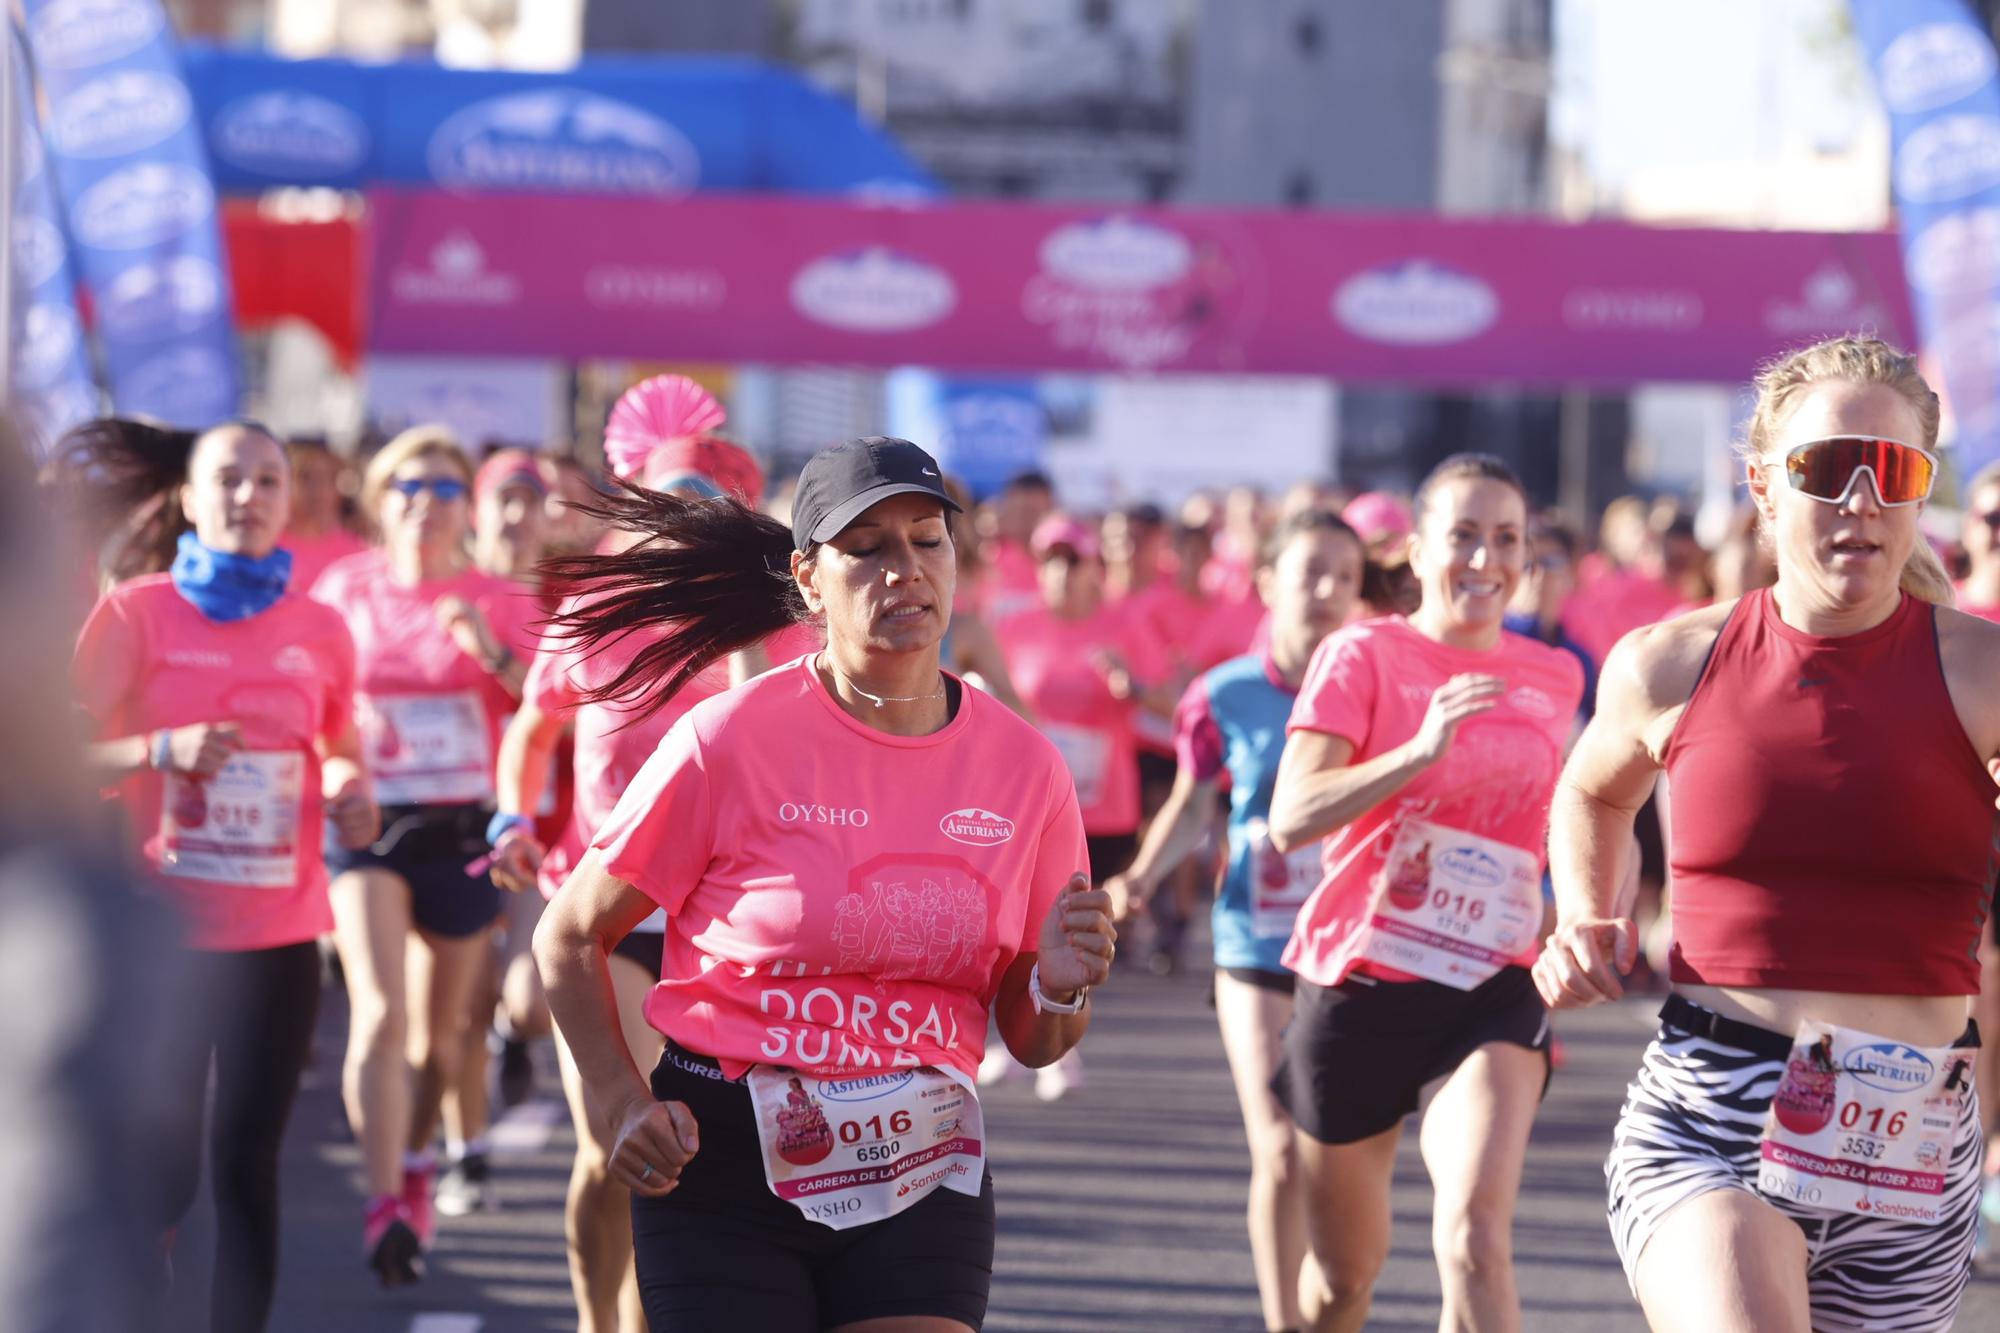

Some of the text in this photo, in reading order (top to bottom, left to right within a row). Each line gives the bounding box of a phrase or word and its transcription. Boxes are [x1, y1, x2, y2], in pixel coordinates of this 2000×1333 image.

[779, 802, 869, 827] OYSHO
[946, 818, 1010, 837] ASTURIANA
[1432, 888, 1485, 921] 016
[760, 987, 960, 1049] DORSAL
[827, 1072, 910, 1096] ASTURIANA
[839, 1110, 912, 1143] 016
[1839, 1101, 1908, 1137] 016
[857, 1140, 900, 1162] 6500
[1842, 1137, 1886, 1160] 3532
[797, 1142, 964, 1193] CARRERA DE LA MUJER 2023
[911, 1162, 969, 1191] Santander
[1831, 1163, 1849, 1176] DE
[1849, 1167, 1866, 1180] LA
[1868, 1171, 1908, 1187] MUJER
[1873, 1200, 1938, 1220] Santander
